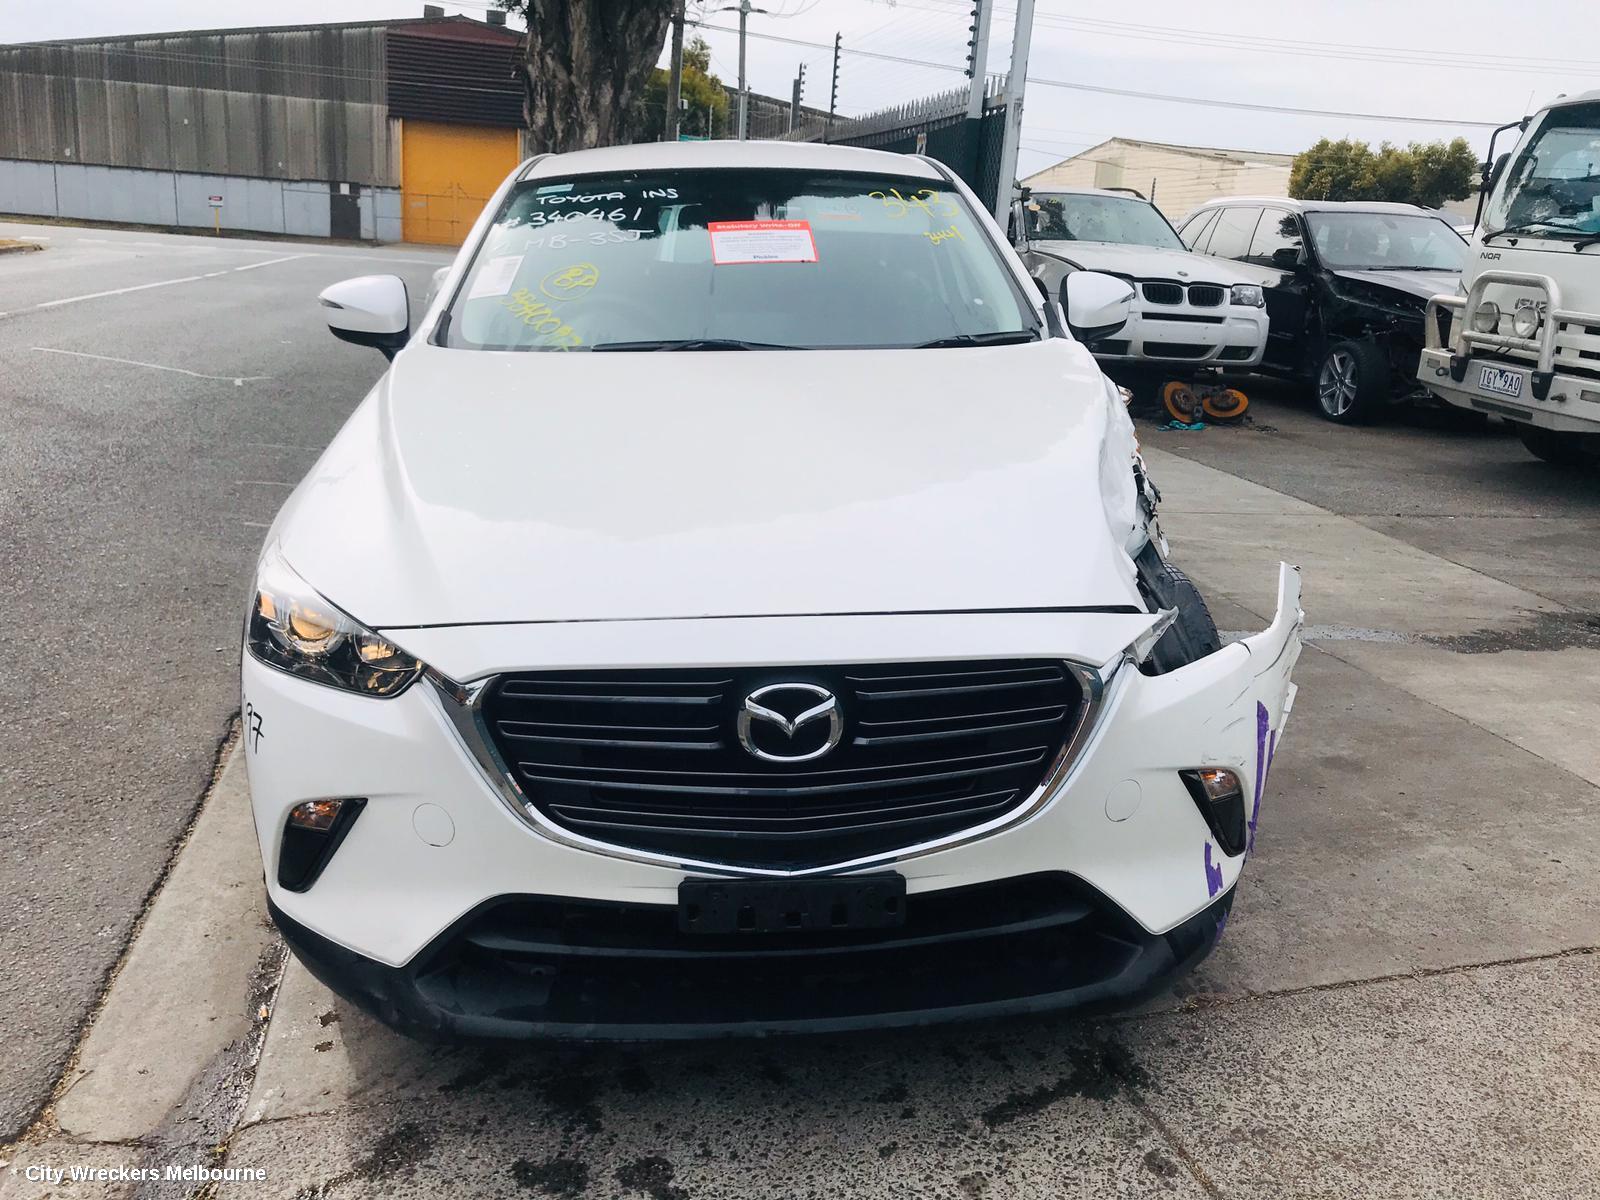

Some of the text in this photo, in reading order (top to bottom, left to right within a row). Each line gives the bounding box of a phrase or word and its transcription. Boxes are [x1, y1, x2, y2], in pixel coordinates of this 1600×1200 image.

[536, 188, 680, 205] TOYOTA INS
[528, 207, 643, 227] 340461
